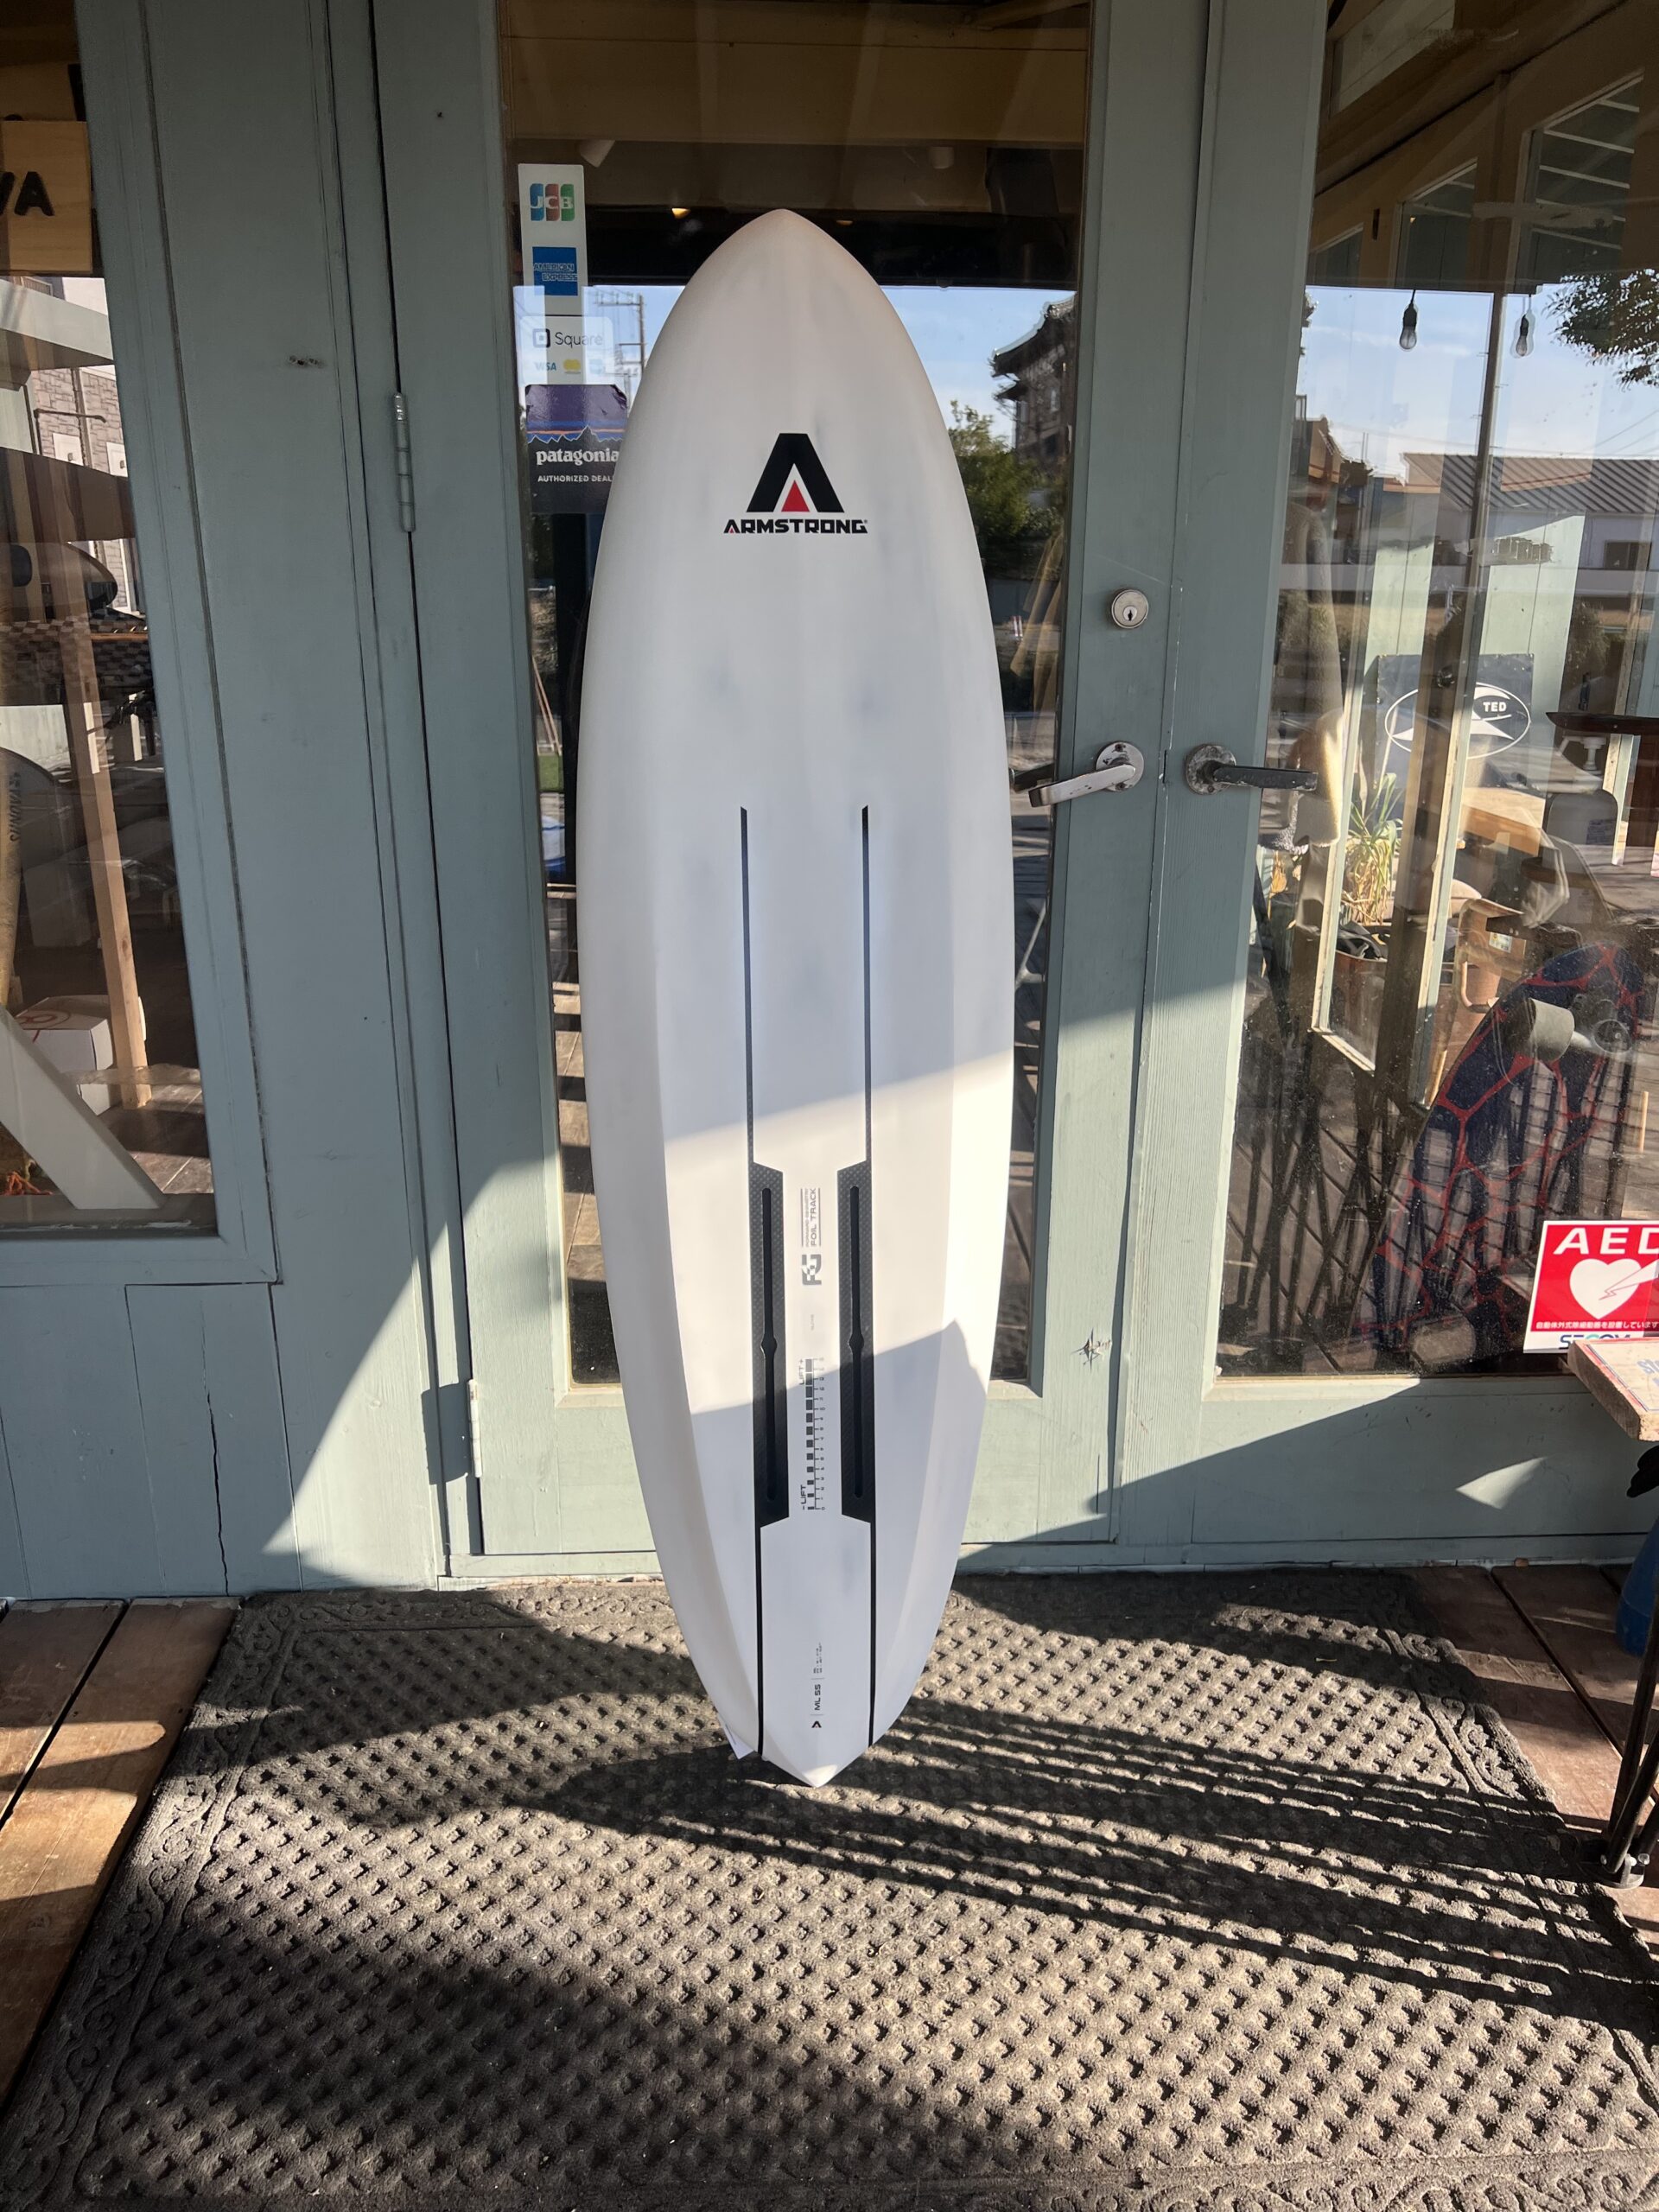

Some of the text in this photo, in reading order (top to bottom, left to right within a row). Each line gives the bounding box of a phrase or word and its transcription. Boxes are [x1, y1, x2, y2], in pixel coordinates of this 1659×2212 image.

[533, 263, 575, 271] AMERICAN
[542, 273, 577, 282] EXPRESS
[555, 332, 603, 348] Square
[534, 362, 556, 371] VISA
[536, 448, 620, 466] patagonia
[723, 519, 868, 534] ARMSTRONG
[1483, 702, 1507, 712] TED
[1553, 1227, 1659, 1255] AED
